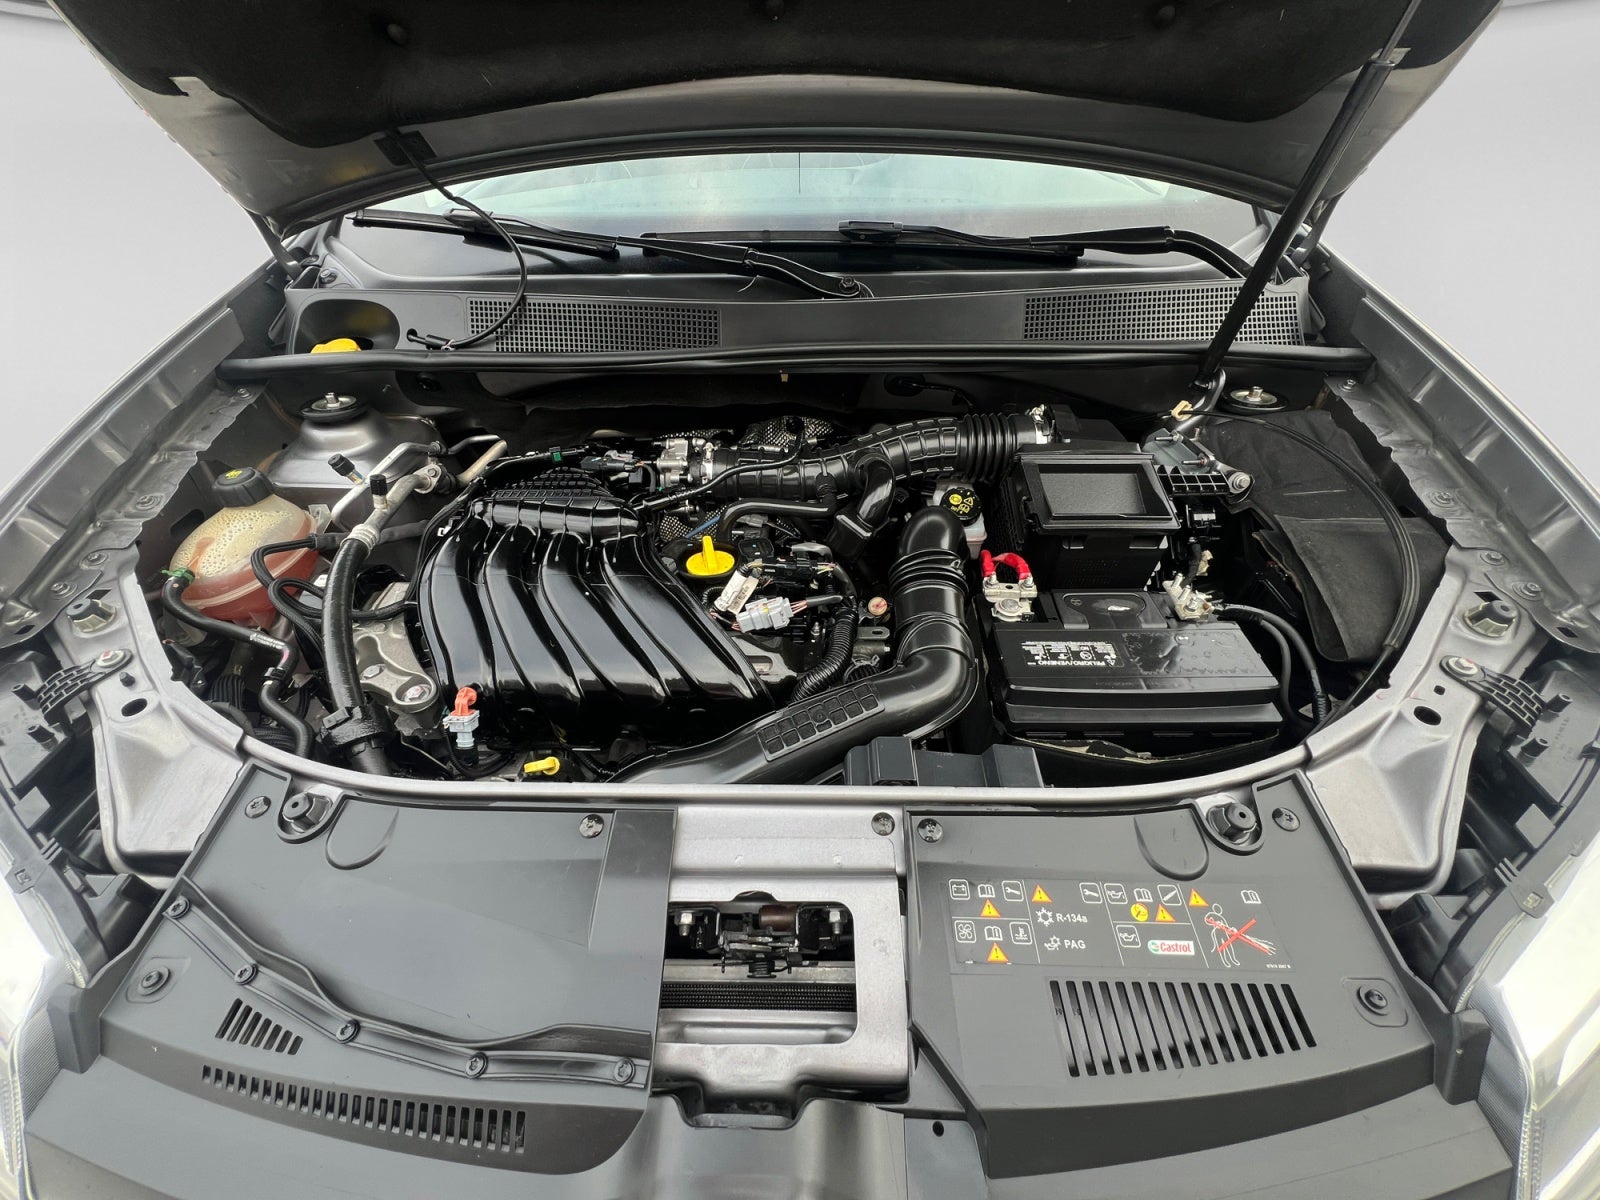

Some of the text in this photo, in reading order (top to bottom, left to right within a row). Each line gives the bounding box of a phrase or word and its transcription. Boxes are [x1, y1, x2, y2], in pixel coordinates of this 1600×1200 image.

[1056, 912, 1088, 923] R-134a
[1063, 939, 1087, 949] PAG
[1160, 942, 1192, 953] Castrol
